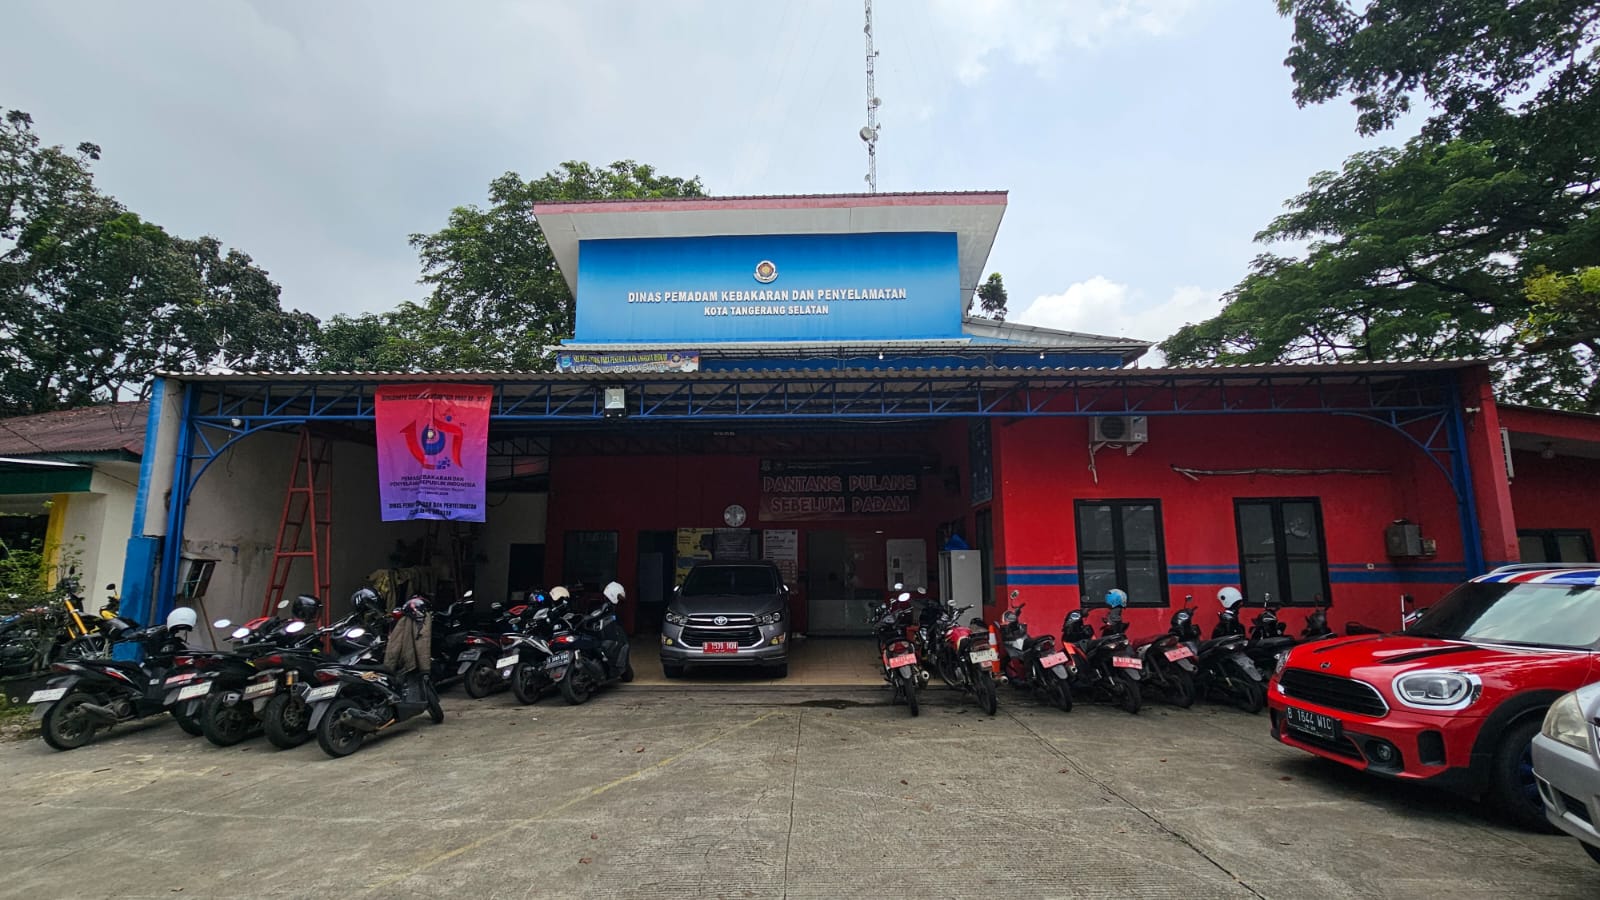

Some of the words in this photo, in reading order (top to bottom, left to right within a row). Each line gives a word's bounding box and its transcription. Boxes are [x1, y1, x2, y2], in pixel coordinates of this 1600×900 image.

[628, 292, 662, 303] DINAS
[664, 291, 718, 303] PEMADAM
[721, 290, 789, 302] KEBAKARAN
[792, 290, 815, 302] DAN
[817, 288, 907, 301] PENYELAMATAN
[704, 306, 729, 316] KOTA
[730, 305, 786, 316] TANGERANG
[788, 304, 829, 315] SELATAN
[763, 475, 843, 492] PANTANG
[848, 474, 917, 492] PULANG
[771, 496, 845, 513] SEBELUM
[851, 495, 910, 513] PADAM
[1288, 708, 1293, 719] B
